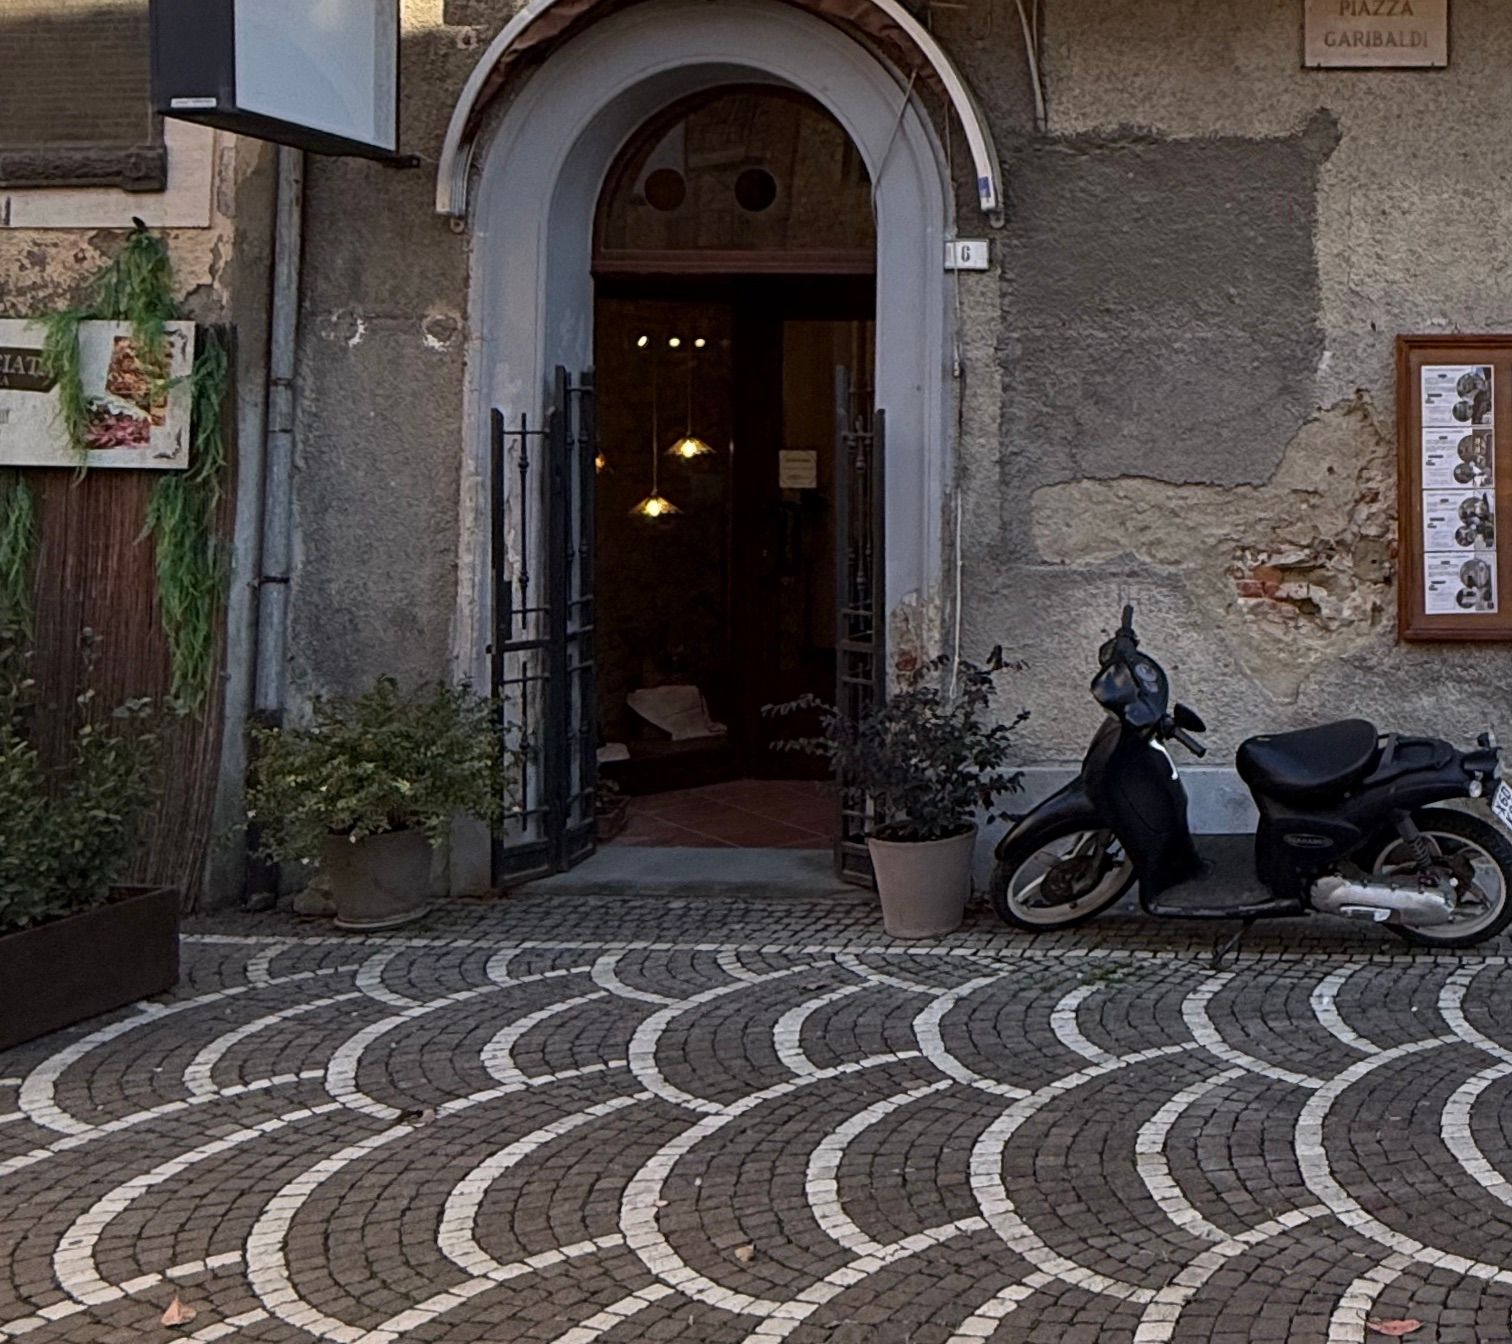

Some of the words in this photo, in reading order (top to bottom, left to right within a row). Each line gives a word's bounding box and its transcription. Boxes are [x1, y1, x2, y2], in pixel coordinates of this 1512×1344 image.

[1339, 0, 1414, 17] PIAZZA
[1324, 30, 1428, 48] GARIBALDI
[961, 245, 970, 262] 6
